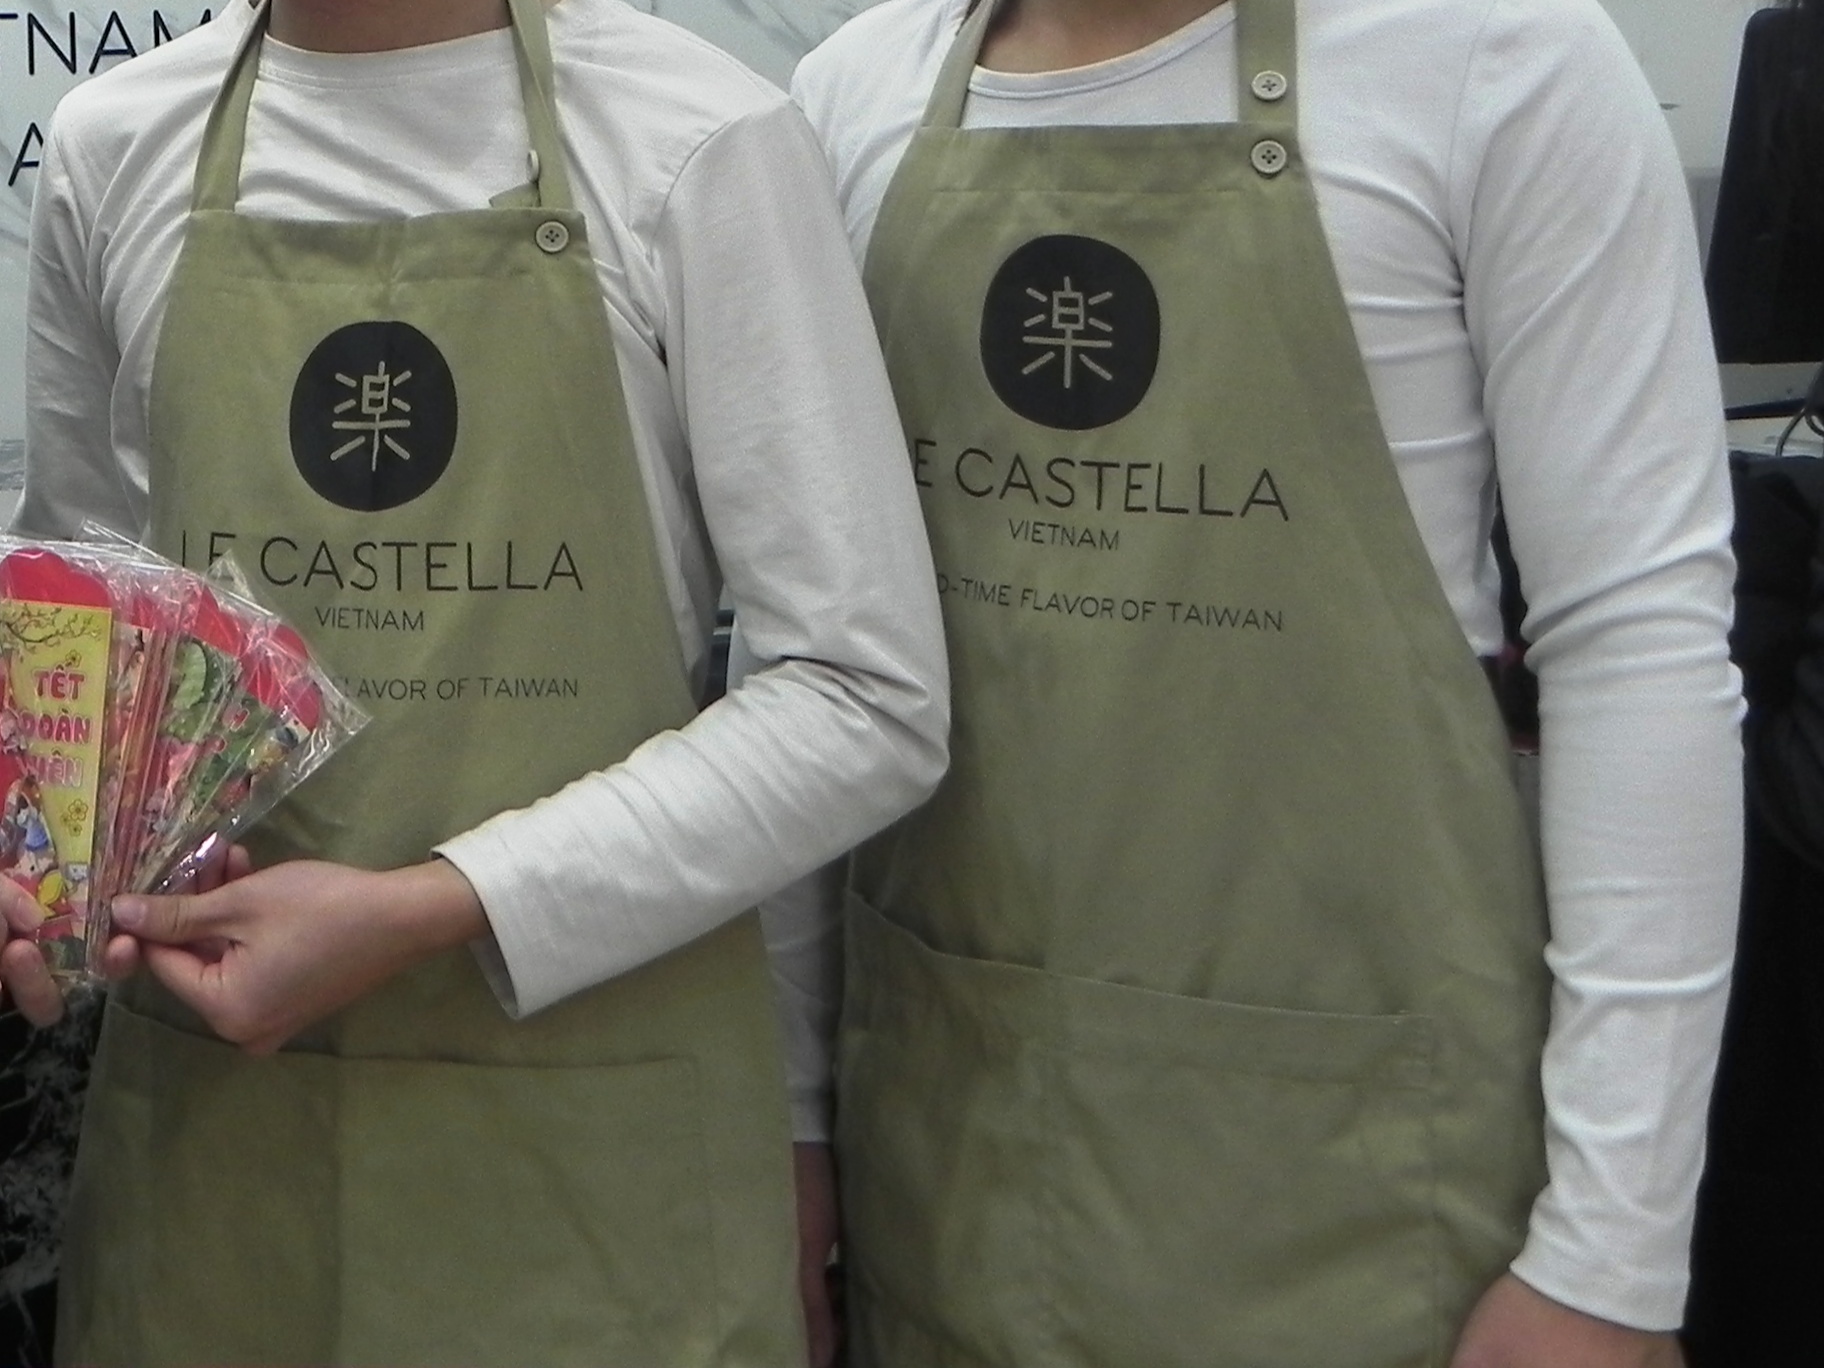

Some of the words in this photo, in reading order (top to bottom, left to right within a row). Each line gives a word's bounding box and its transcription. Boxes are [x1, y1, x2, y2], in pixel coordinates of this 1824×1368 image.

[955, 447, 1290, 522] CASTELLA
[1008, 518, 1120, 551] VIETNAM
[260, 536, 584, 592] CASTELLA
[315, 606, 425, 631] VIETNAM
[1020, 588, 1115, 619] FLAVOR
[1121, 599, 1157, 621] OF
[1166, 602, 1283, 632] TAIWAN
[436, 677, 470, 701] OF
[479, 677, 578, 699] TAIWAN
